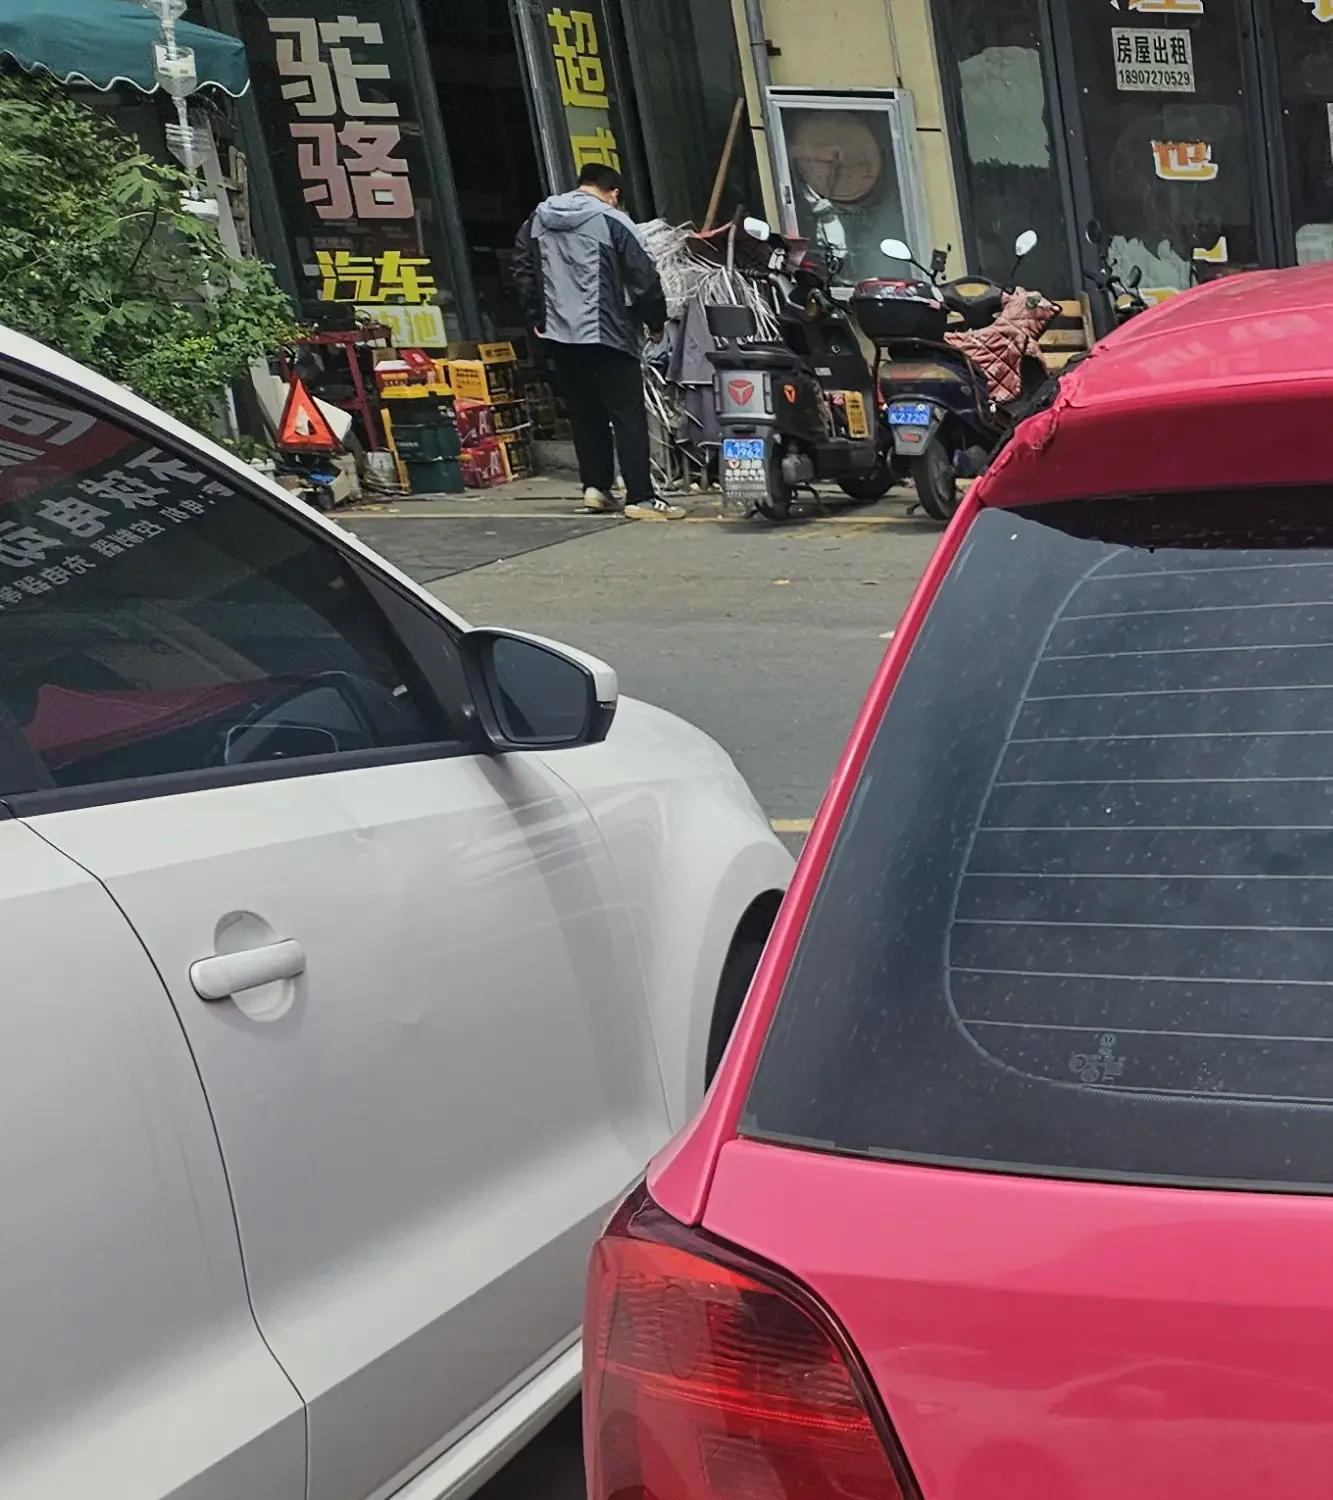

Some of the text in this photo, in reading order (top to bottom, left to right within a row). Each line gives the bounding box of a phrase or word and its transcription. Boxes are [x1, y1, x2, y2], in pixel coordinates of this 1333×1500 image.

[1117, 35, 1188, 64] 房屋出租
[1119, 69, 1190, 85] 18907270529
[316, 250, 438, 302] 汽车
